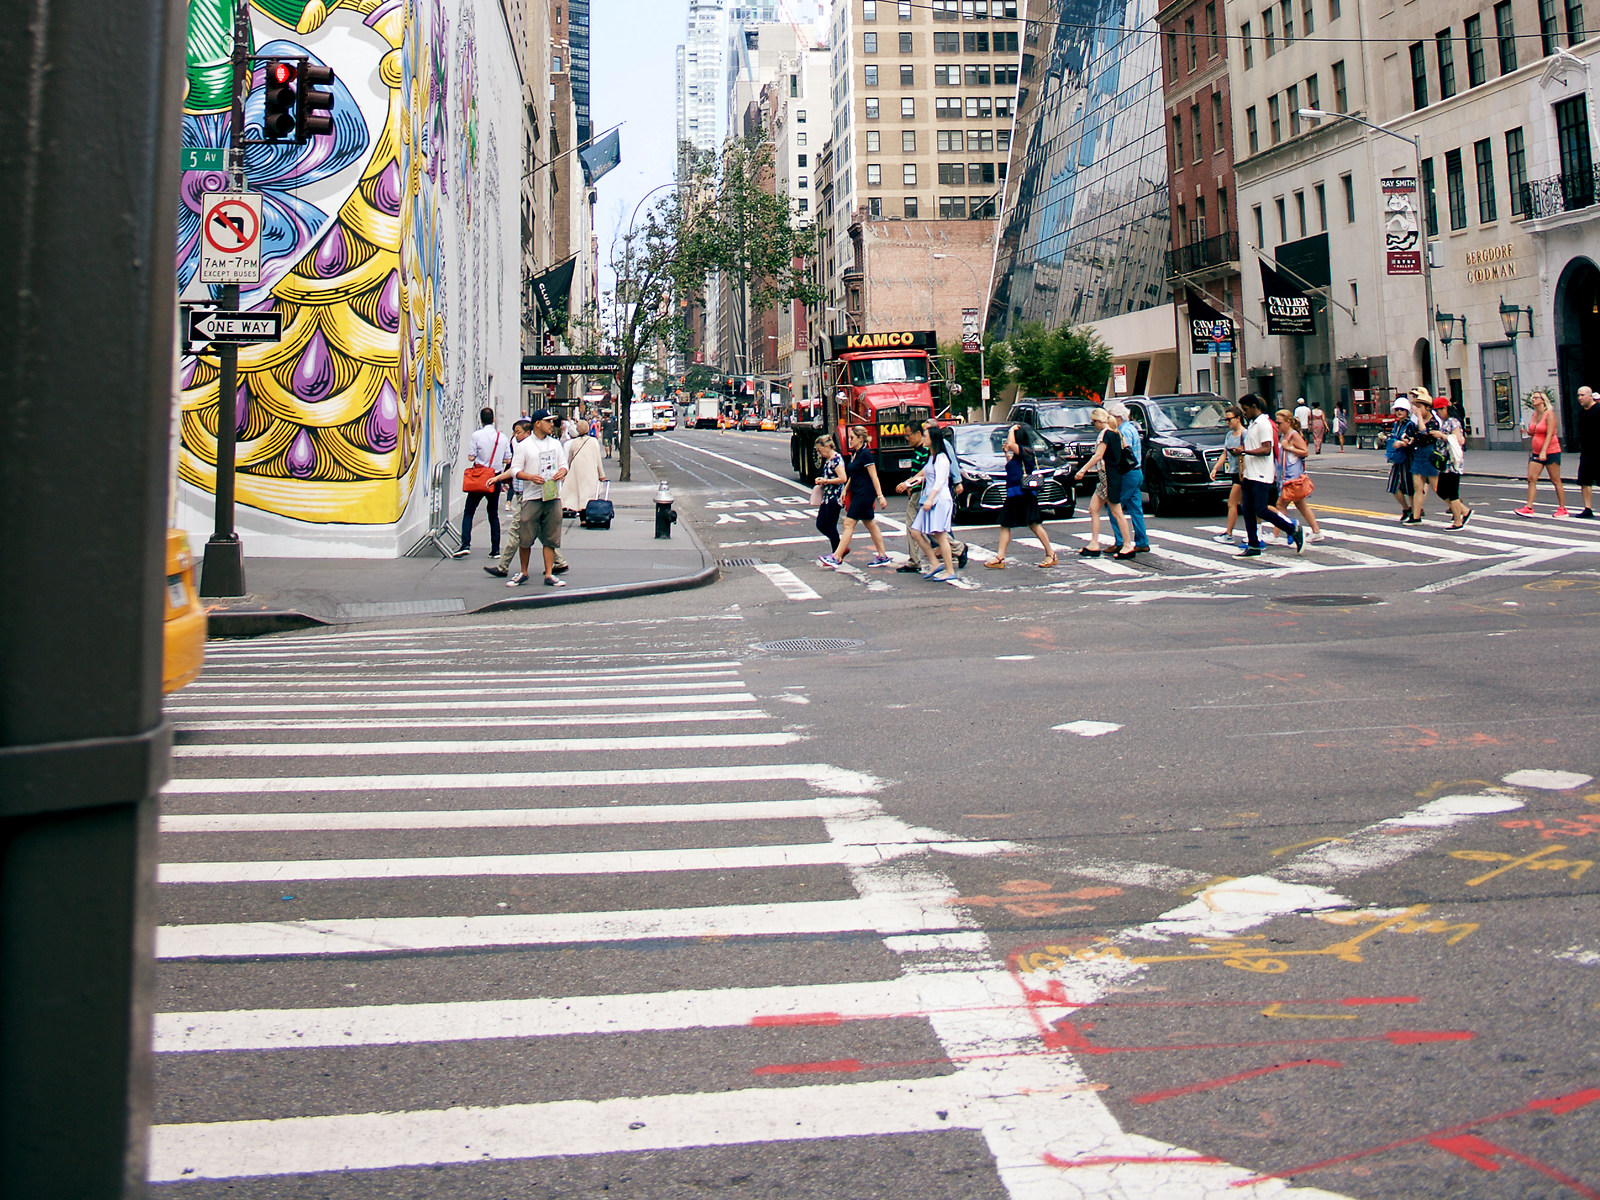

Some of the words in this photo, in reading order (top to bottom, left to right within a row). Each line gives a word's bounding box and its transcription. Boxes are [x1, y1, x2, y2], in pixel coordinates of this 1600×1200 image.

[189, 151, 198, 168] 5
[1395, 179, 1415, 188] SMITH
[1465, 243, 1513, 266] BERGDORF
[233, 270, 257, 278] BUSES
[1467, 261, 1515, 284] GOODMAN
[538, 282, 551, 306] CLUB
[1268, 295, 1310, 307] CAVALIER
[1269, 305, 1310, 316] GALLERY
[207, 320, 234, 333] ONE
[241, 321, 269, 333] WAY
[847, 332, 915, 348] KAMCO
